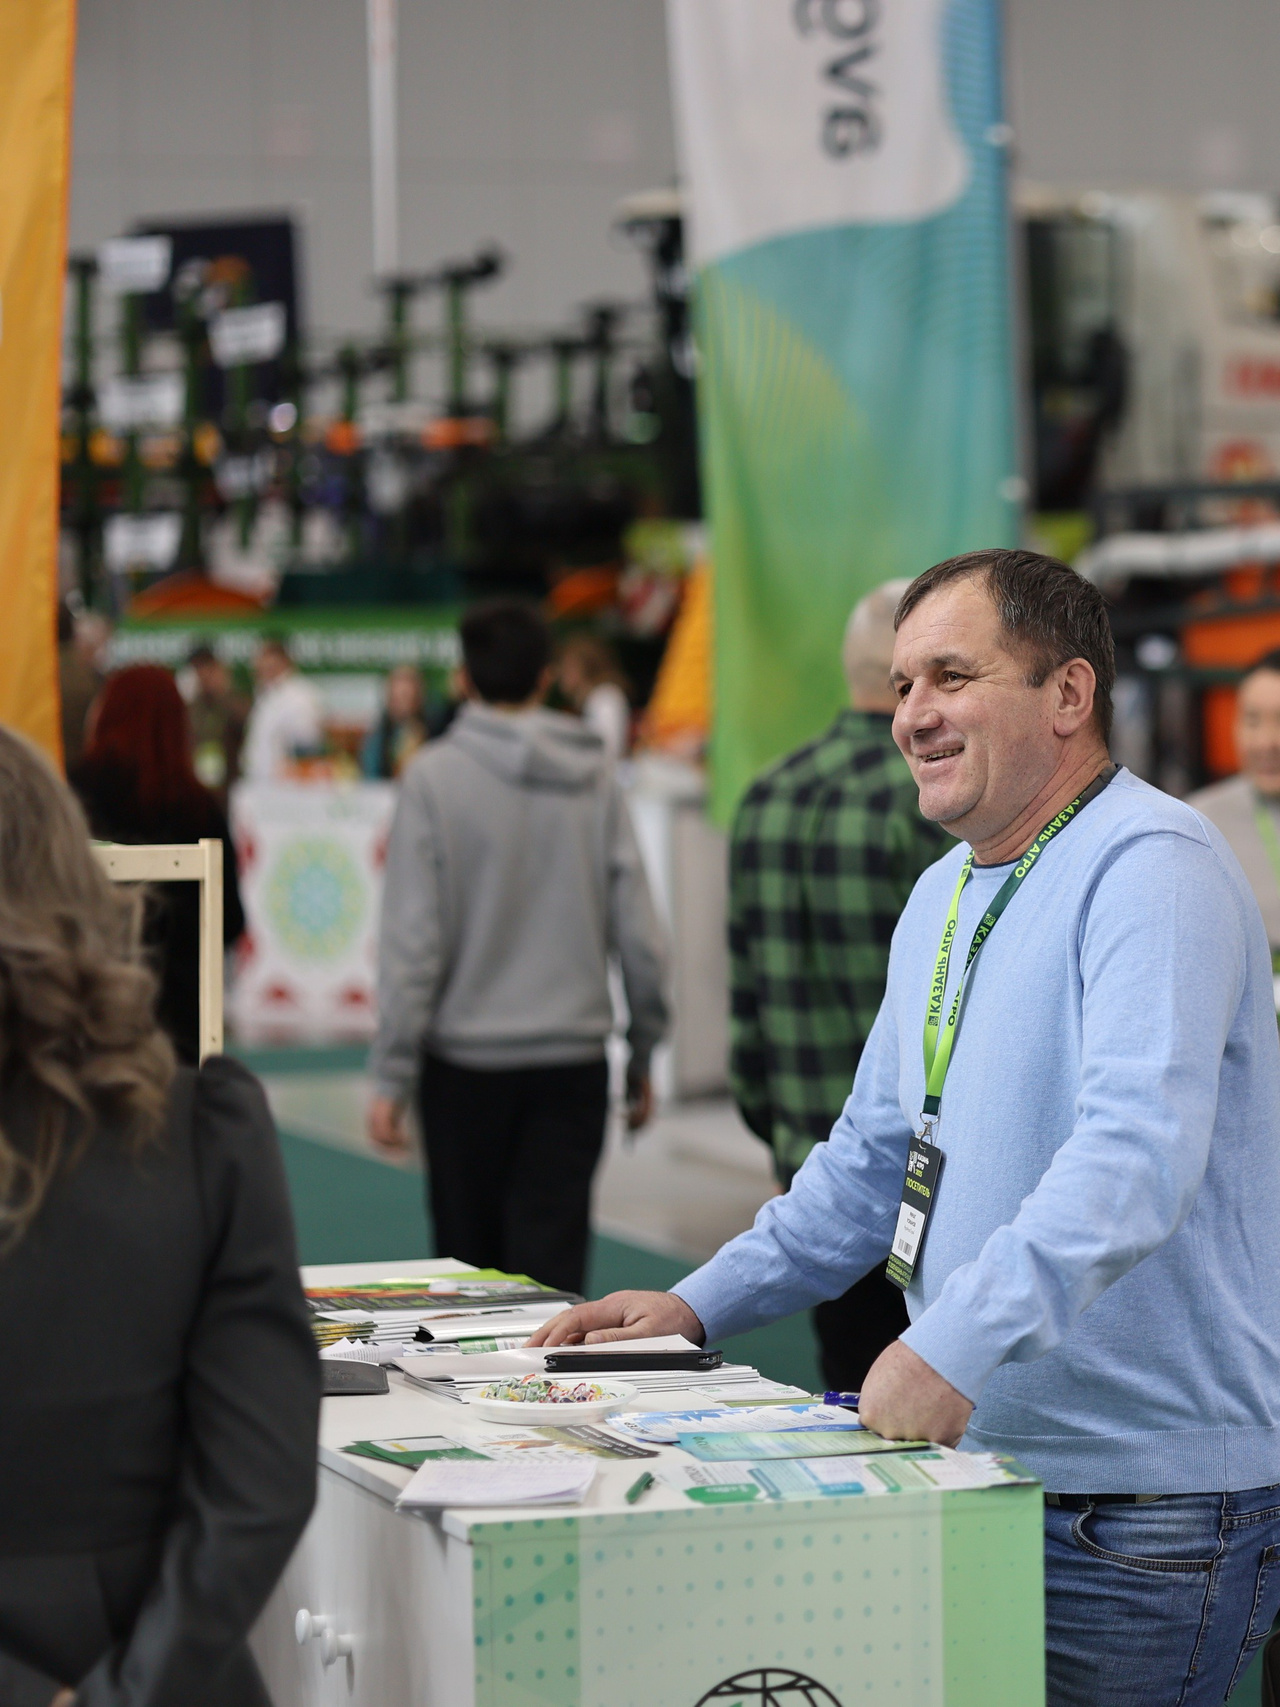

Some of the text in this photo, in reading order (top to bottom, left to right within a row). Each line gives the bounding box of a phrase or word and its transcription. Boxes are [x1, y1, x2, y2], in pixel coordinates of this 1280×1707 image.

[1015, 843, 1041, 878] АГРО
[931, 919, 956, 1013] КАЗАНЬ АГРО
